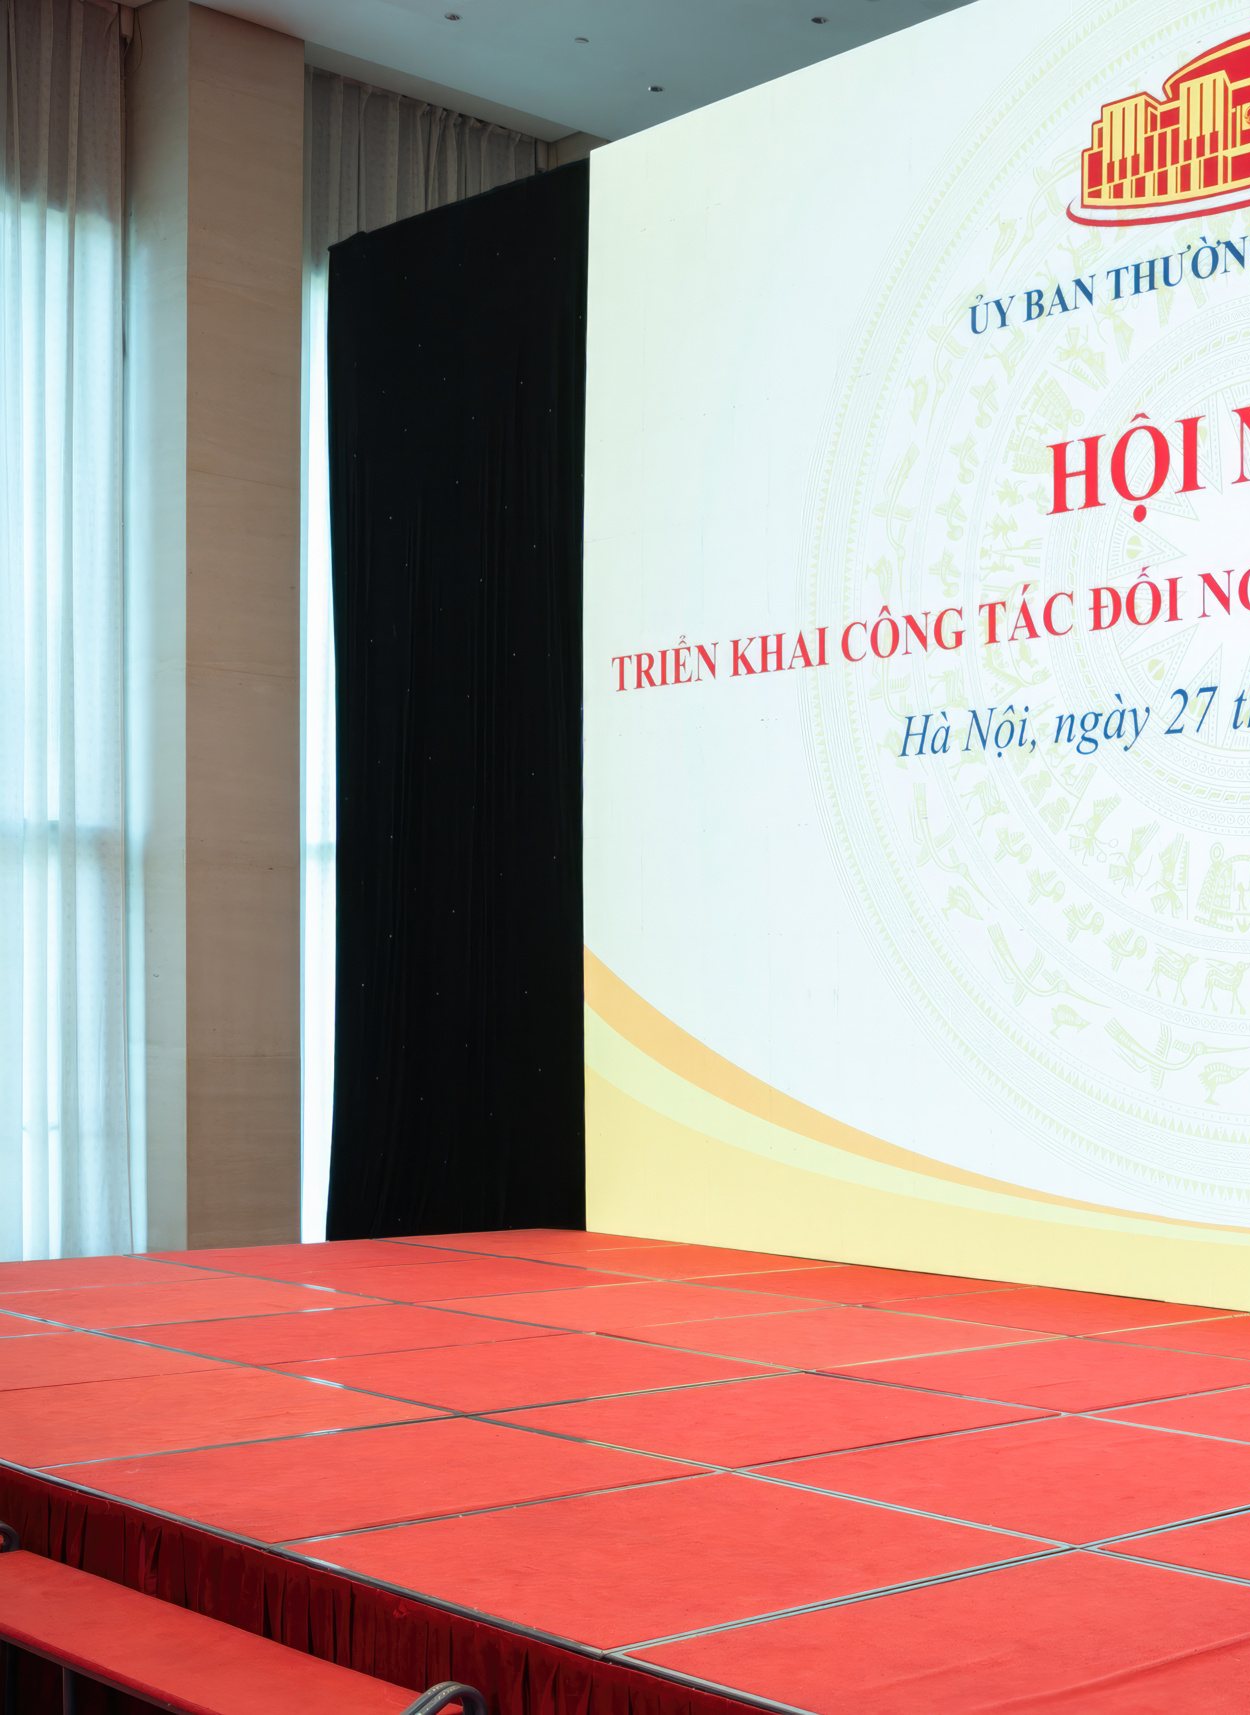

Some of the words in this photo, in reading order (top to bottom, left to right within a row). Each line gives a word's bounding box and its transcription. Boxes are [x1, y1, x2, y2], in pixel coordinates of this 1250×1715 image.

[969, 294, 1015, 335] ỦY
[1023, 275, 1095, 322] BAN
[1046, 412, 1206, 523] HỘI
[611, 634, 719, 692] TRIỂN
[729, 625, 828, 678] KHAI
[841, 605, 966, 662] CÔNG
[977, 584, 1074, 645] TÁC
[1088, 566, 1182, 631] ĐỐI
[898, 711, 951, 757] Hà
[962, 704, 1036, 759] Nội,
[1053, 693, 1151, 755] ngày
[1164, 686, 1219, 736] 27
